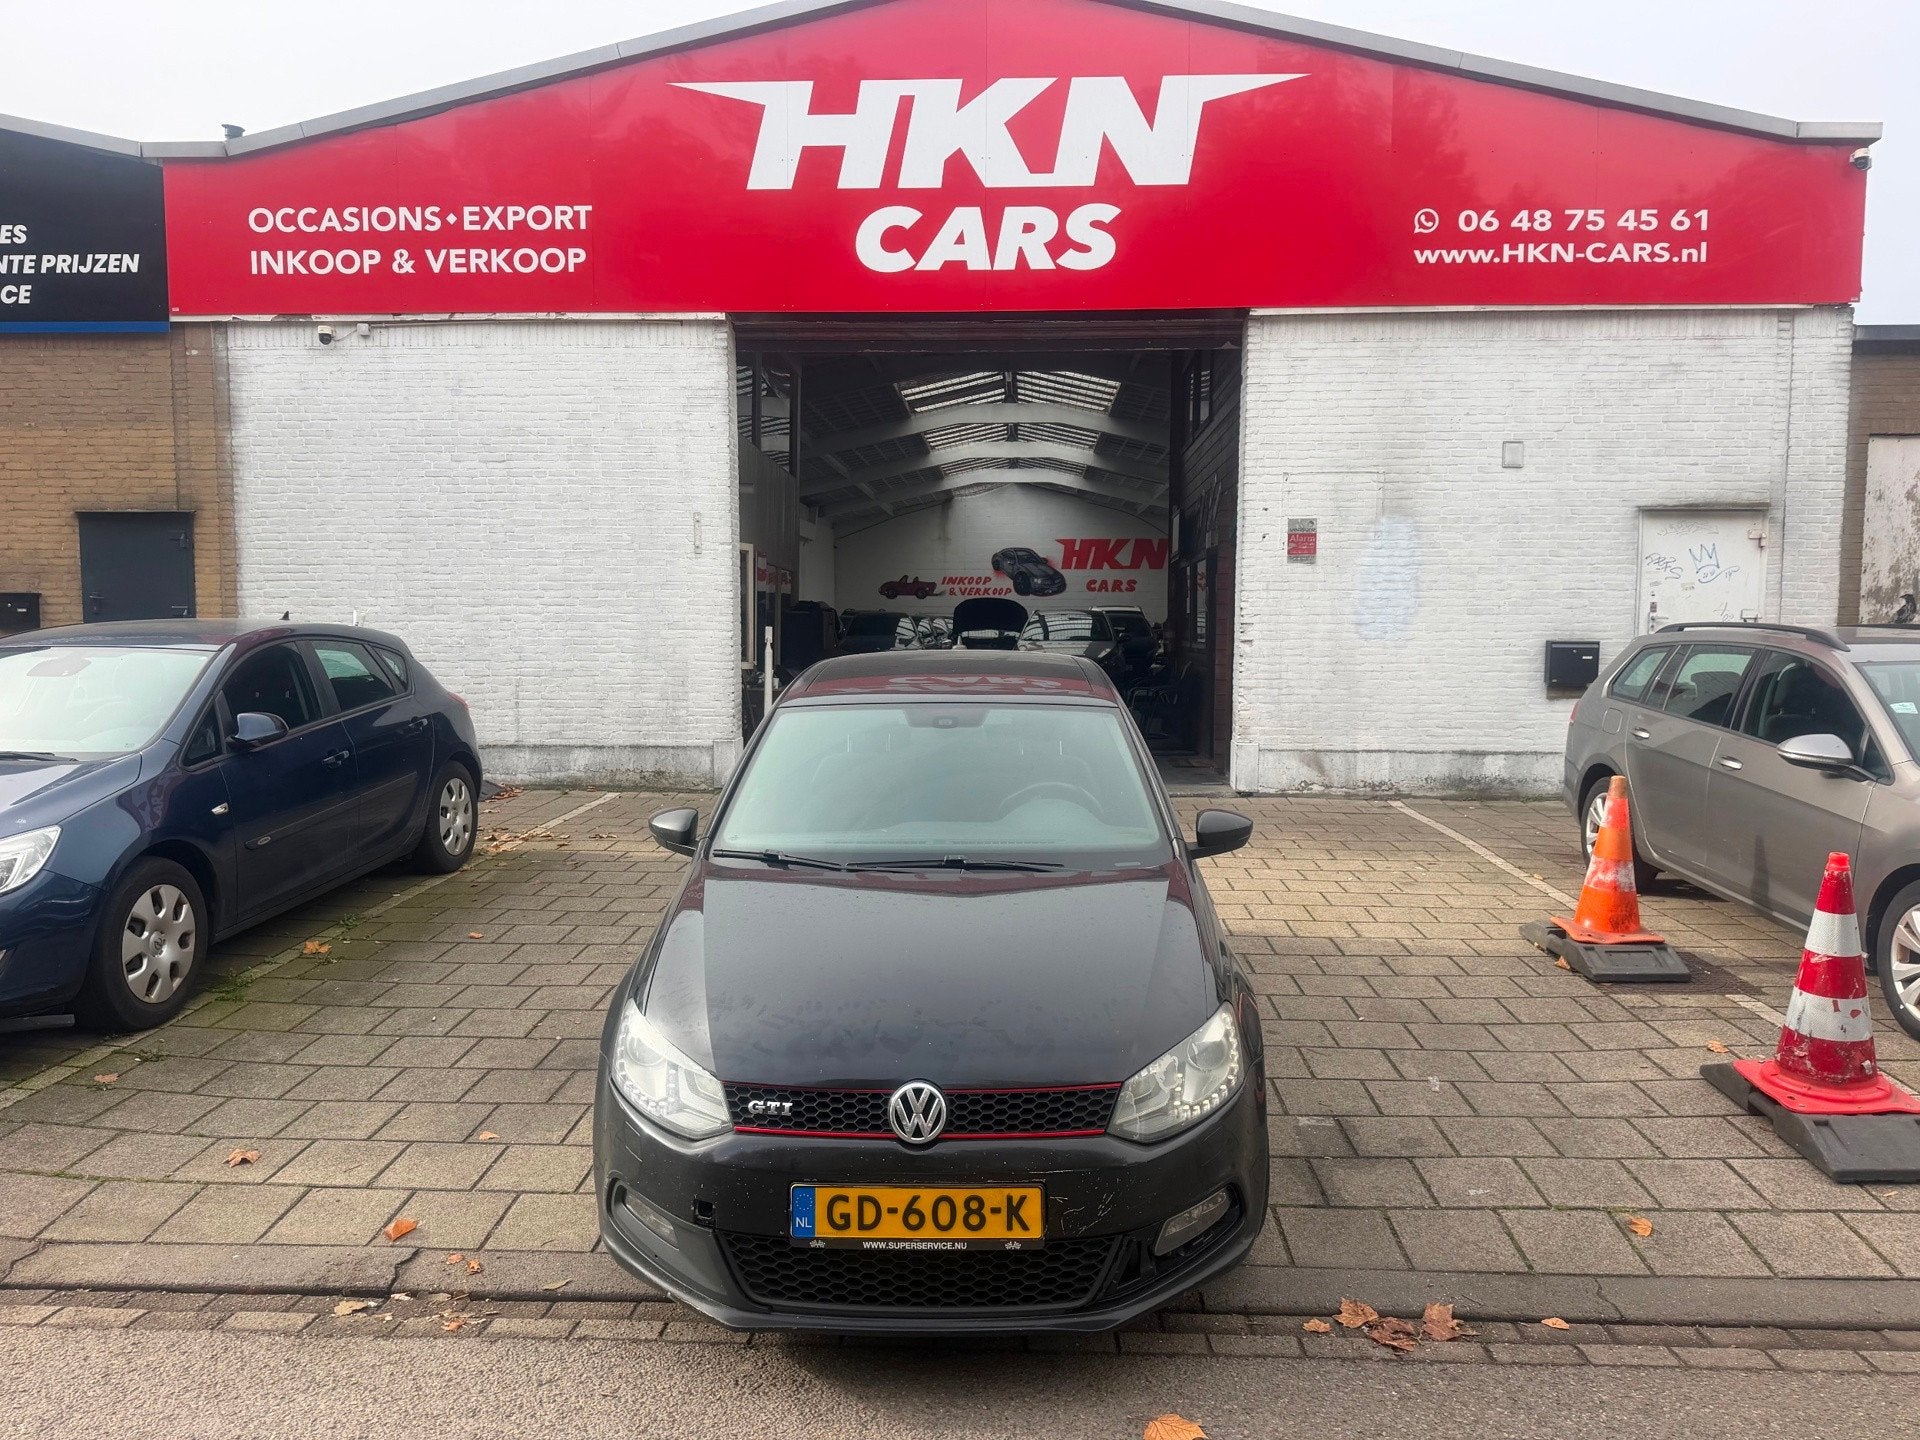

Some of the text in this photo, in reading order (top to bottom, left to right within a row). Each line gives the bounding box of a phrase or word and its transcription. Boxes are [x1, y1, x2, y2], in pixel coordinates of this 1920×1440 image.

[666, 73, 1312, 190] HKN
[248, 204, 593, 233] OCCASIONS EXPORT
[1458, 208, 1709, 232] 06 48 75 45 61
[0, 224, 27, 244] ES
[855, 203, 1122, 273] CARS
[40, 253, 140, 274] PRIJZEN
[250, 247, 587, 275] INKOOP & VERKOOP
[1413, 242, 1707, 264] www.HKN-CARS.nl
[0, 284, 32, 304] CE
[1055, 538, 1169, 570] HKN
[941, 576, 992, 586] INKOOP
[1086, 579, 1138, 593] CARS
[949, 587, 1012, 597] & VERKOOP
[747, 1099, 794, 1117] GTI
[889, 1081, 947, 1144] VW
[795, 1216, 812, 1229] NL
[826, 1194, 1031, 1232] GD-608-K
[862, 1241, 968, 1250] WWW.SUPERSERVICE.NU
